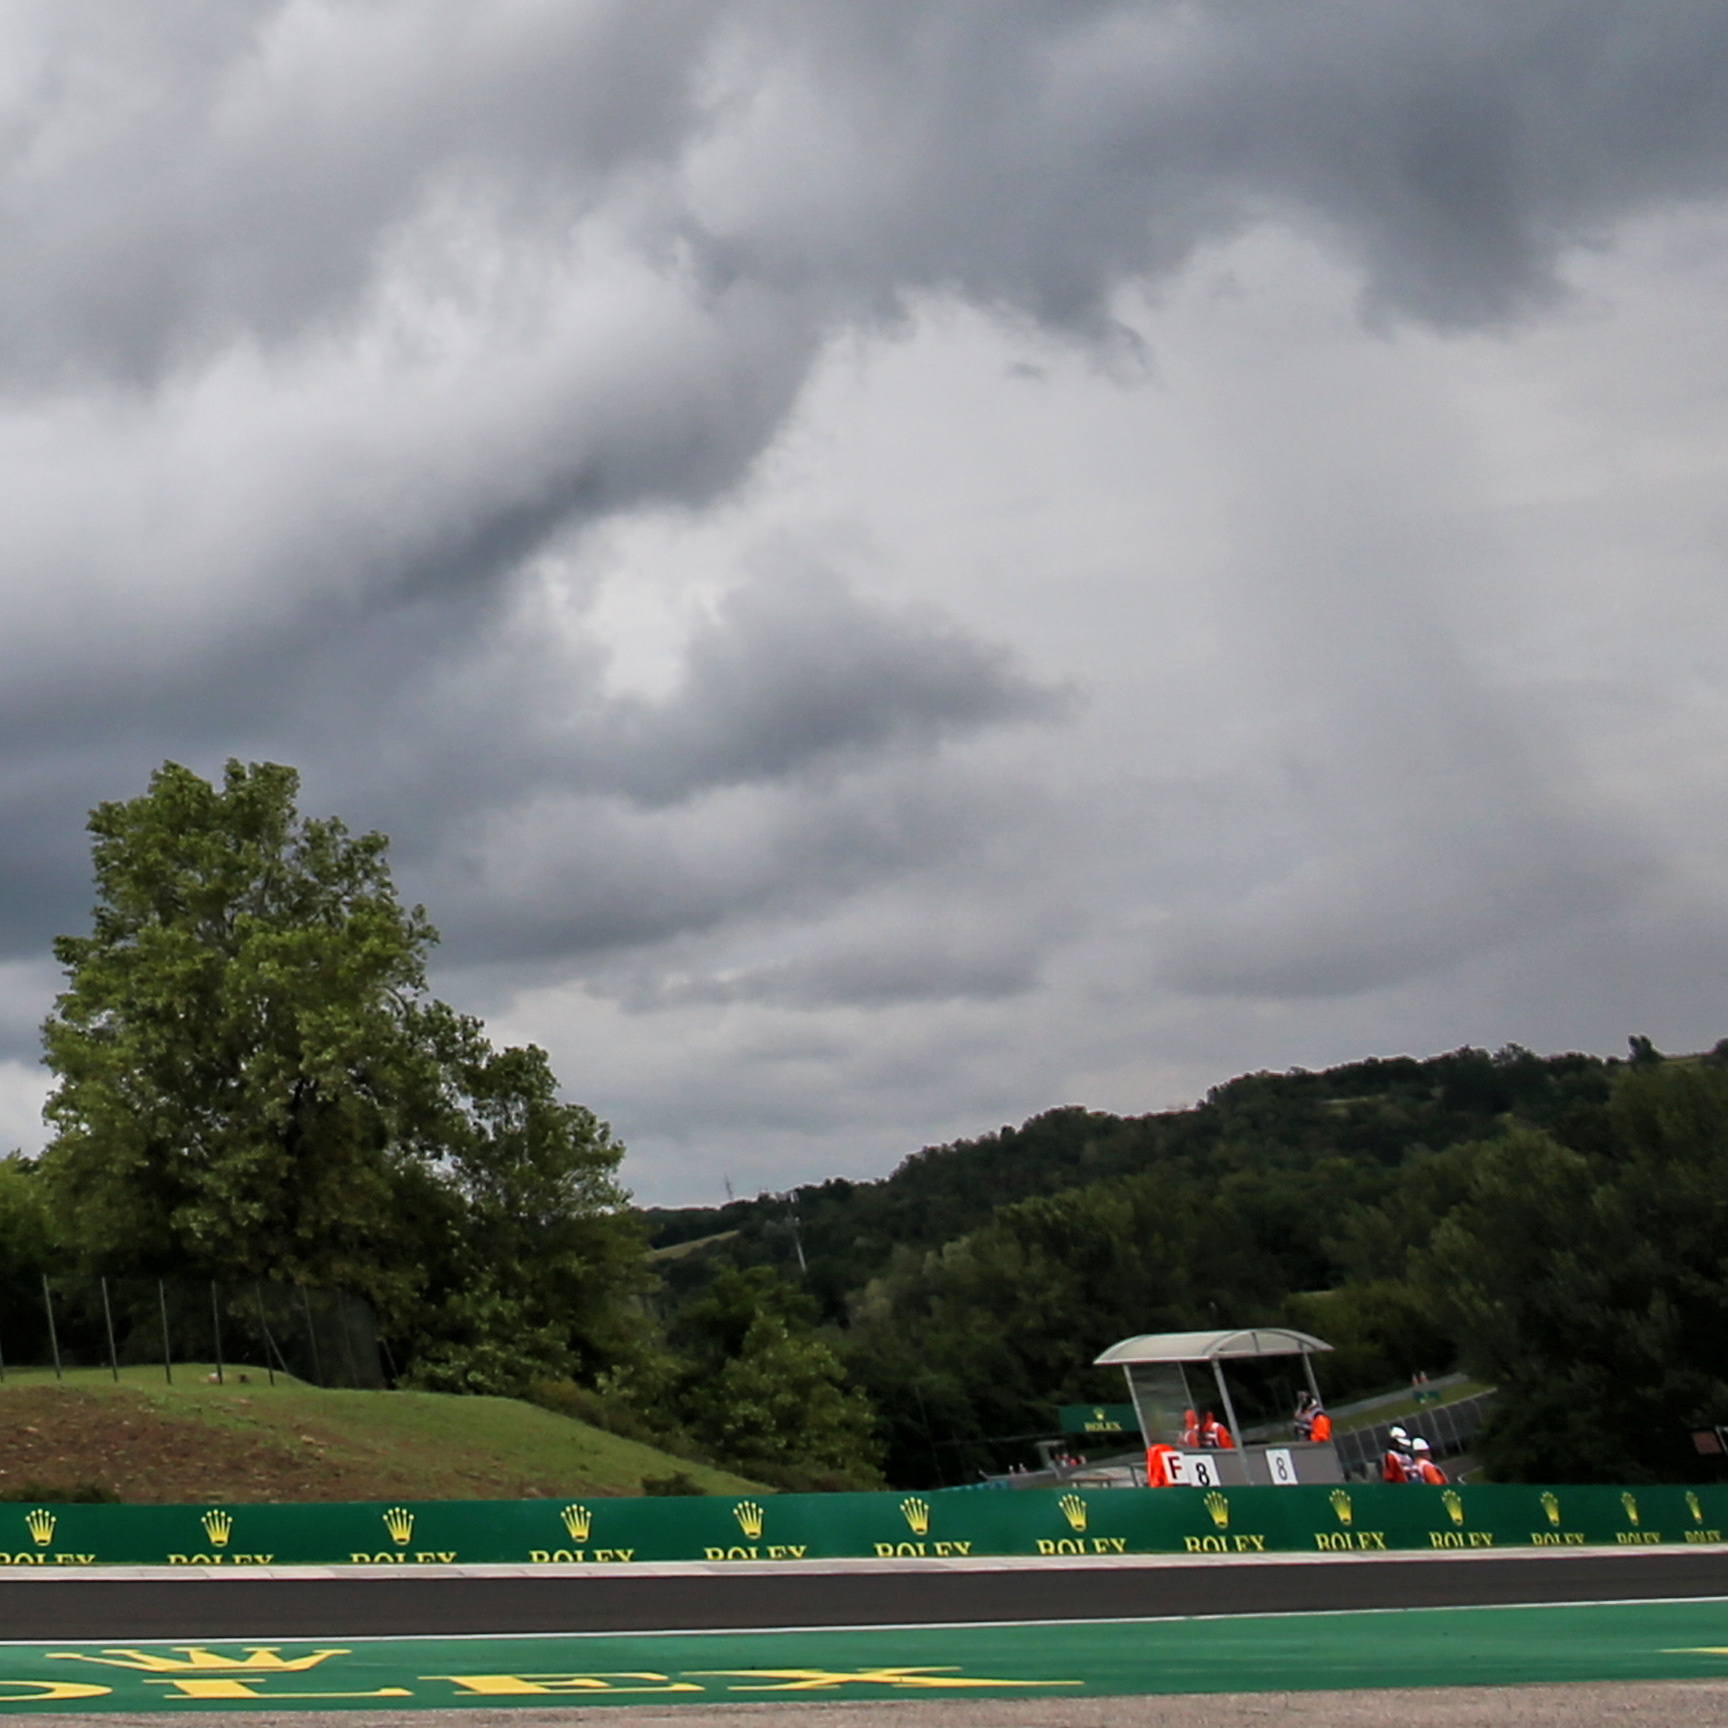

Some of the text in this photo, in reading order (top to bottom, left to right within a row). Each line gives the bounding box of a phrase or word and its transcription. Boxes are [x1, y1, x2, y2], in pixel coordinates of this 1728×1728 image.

[1167, 1456, 1182, 1479] F
[1195, 1462, 1210, 1486] 8
[1276, 1457, 1288, 1480] 8
[1036, 1538, 1127, 1554] ROLEX
[1184, 1535, 1267, 1551] ROLEX
[1315, 1532, 1387, 1549] ROLEX
[1430, 1532, 1493, 1548] ROLEX
